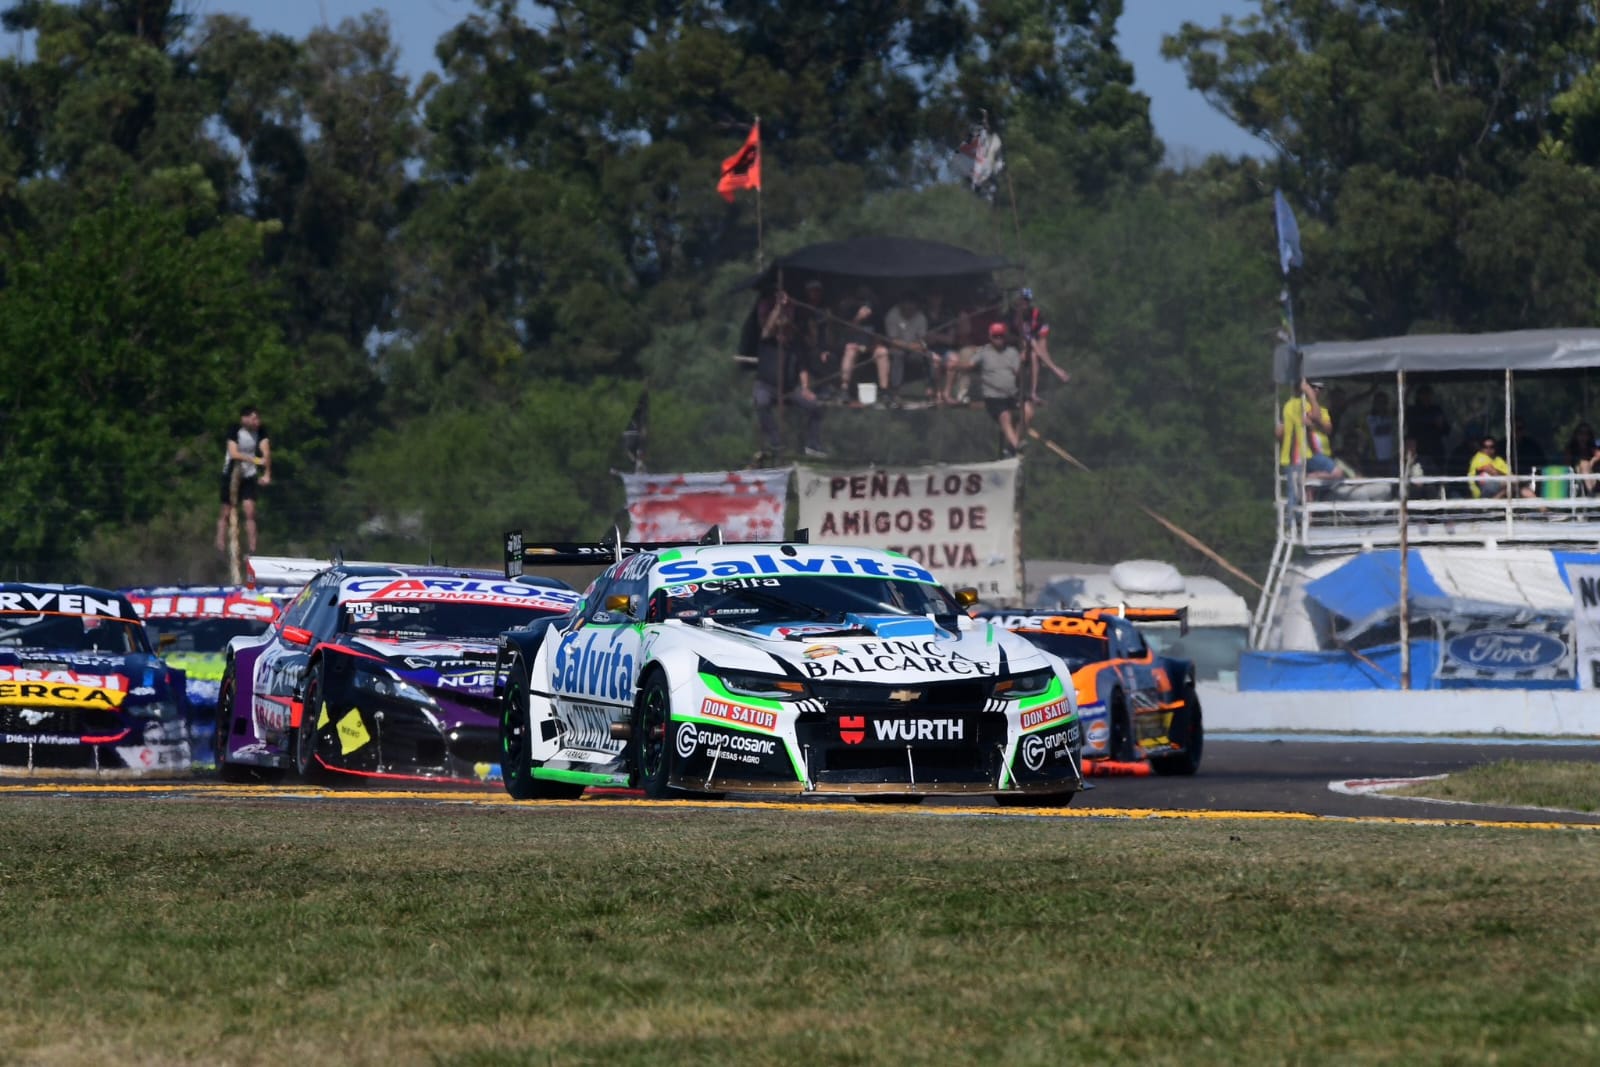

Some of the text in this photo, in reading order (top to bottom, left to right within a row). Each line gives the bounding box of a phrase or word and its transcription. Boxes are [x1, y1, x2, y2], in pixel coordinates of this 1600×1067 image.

[829, 471, 983, 499] PEÑA LOS
[820, 506, 987, 536] AMIGOS DE
[657, 555, 935, 584] Salvita
[347, 578, 582, 604] CARLOS
[975, 615, 1108, 636] ADECON
[861, 640, 975, 661] FINCA
[1468, 635, 1541, 663] Ford
[552, 631, 633, 701] Salvita
[801, 653, 998, 679] BALCARCE
[703, 699, 774, 727] DON SATUR
[1023, 710, 1043, 728] DON
[873, 717, 964, 741] WÜRTH
[742, 754, 760, 765] AGRO
